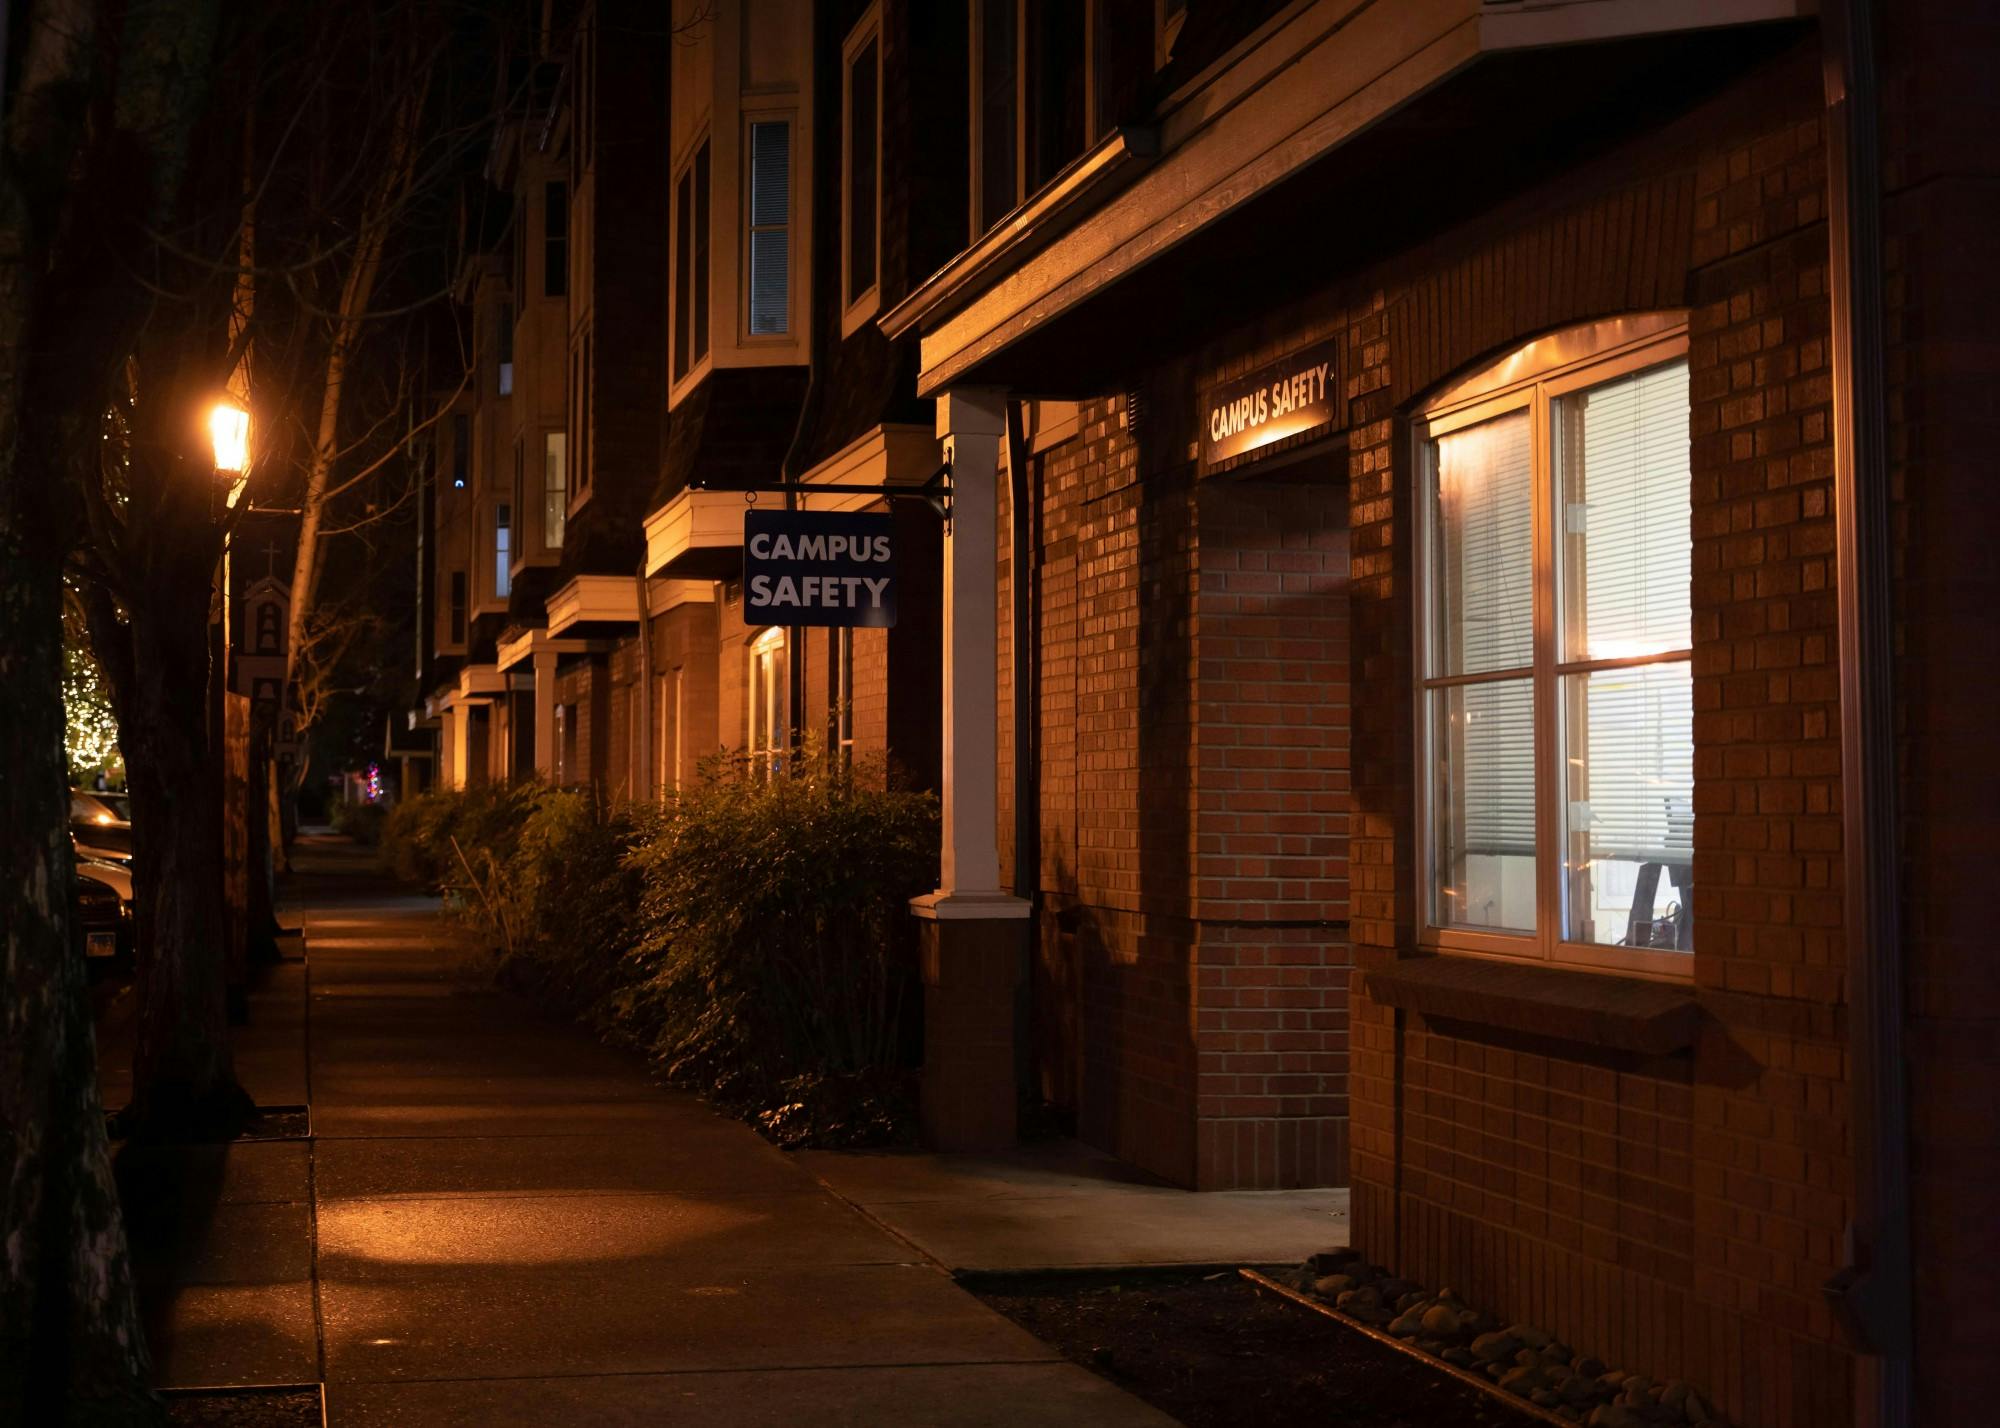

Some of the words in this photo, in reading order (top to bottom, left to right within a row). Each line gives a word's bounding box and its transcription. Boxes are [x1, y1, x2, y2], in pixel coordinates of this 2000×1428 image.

[1211, 388, 1267, 442] CAMPUS
[1272, 362, 1329, 418] SAFETY
[750, 533, 891, 562] CAMPUS
[750, 575, 890, 608] SAFETY
